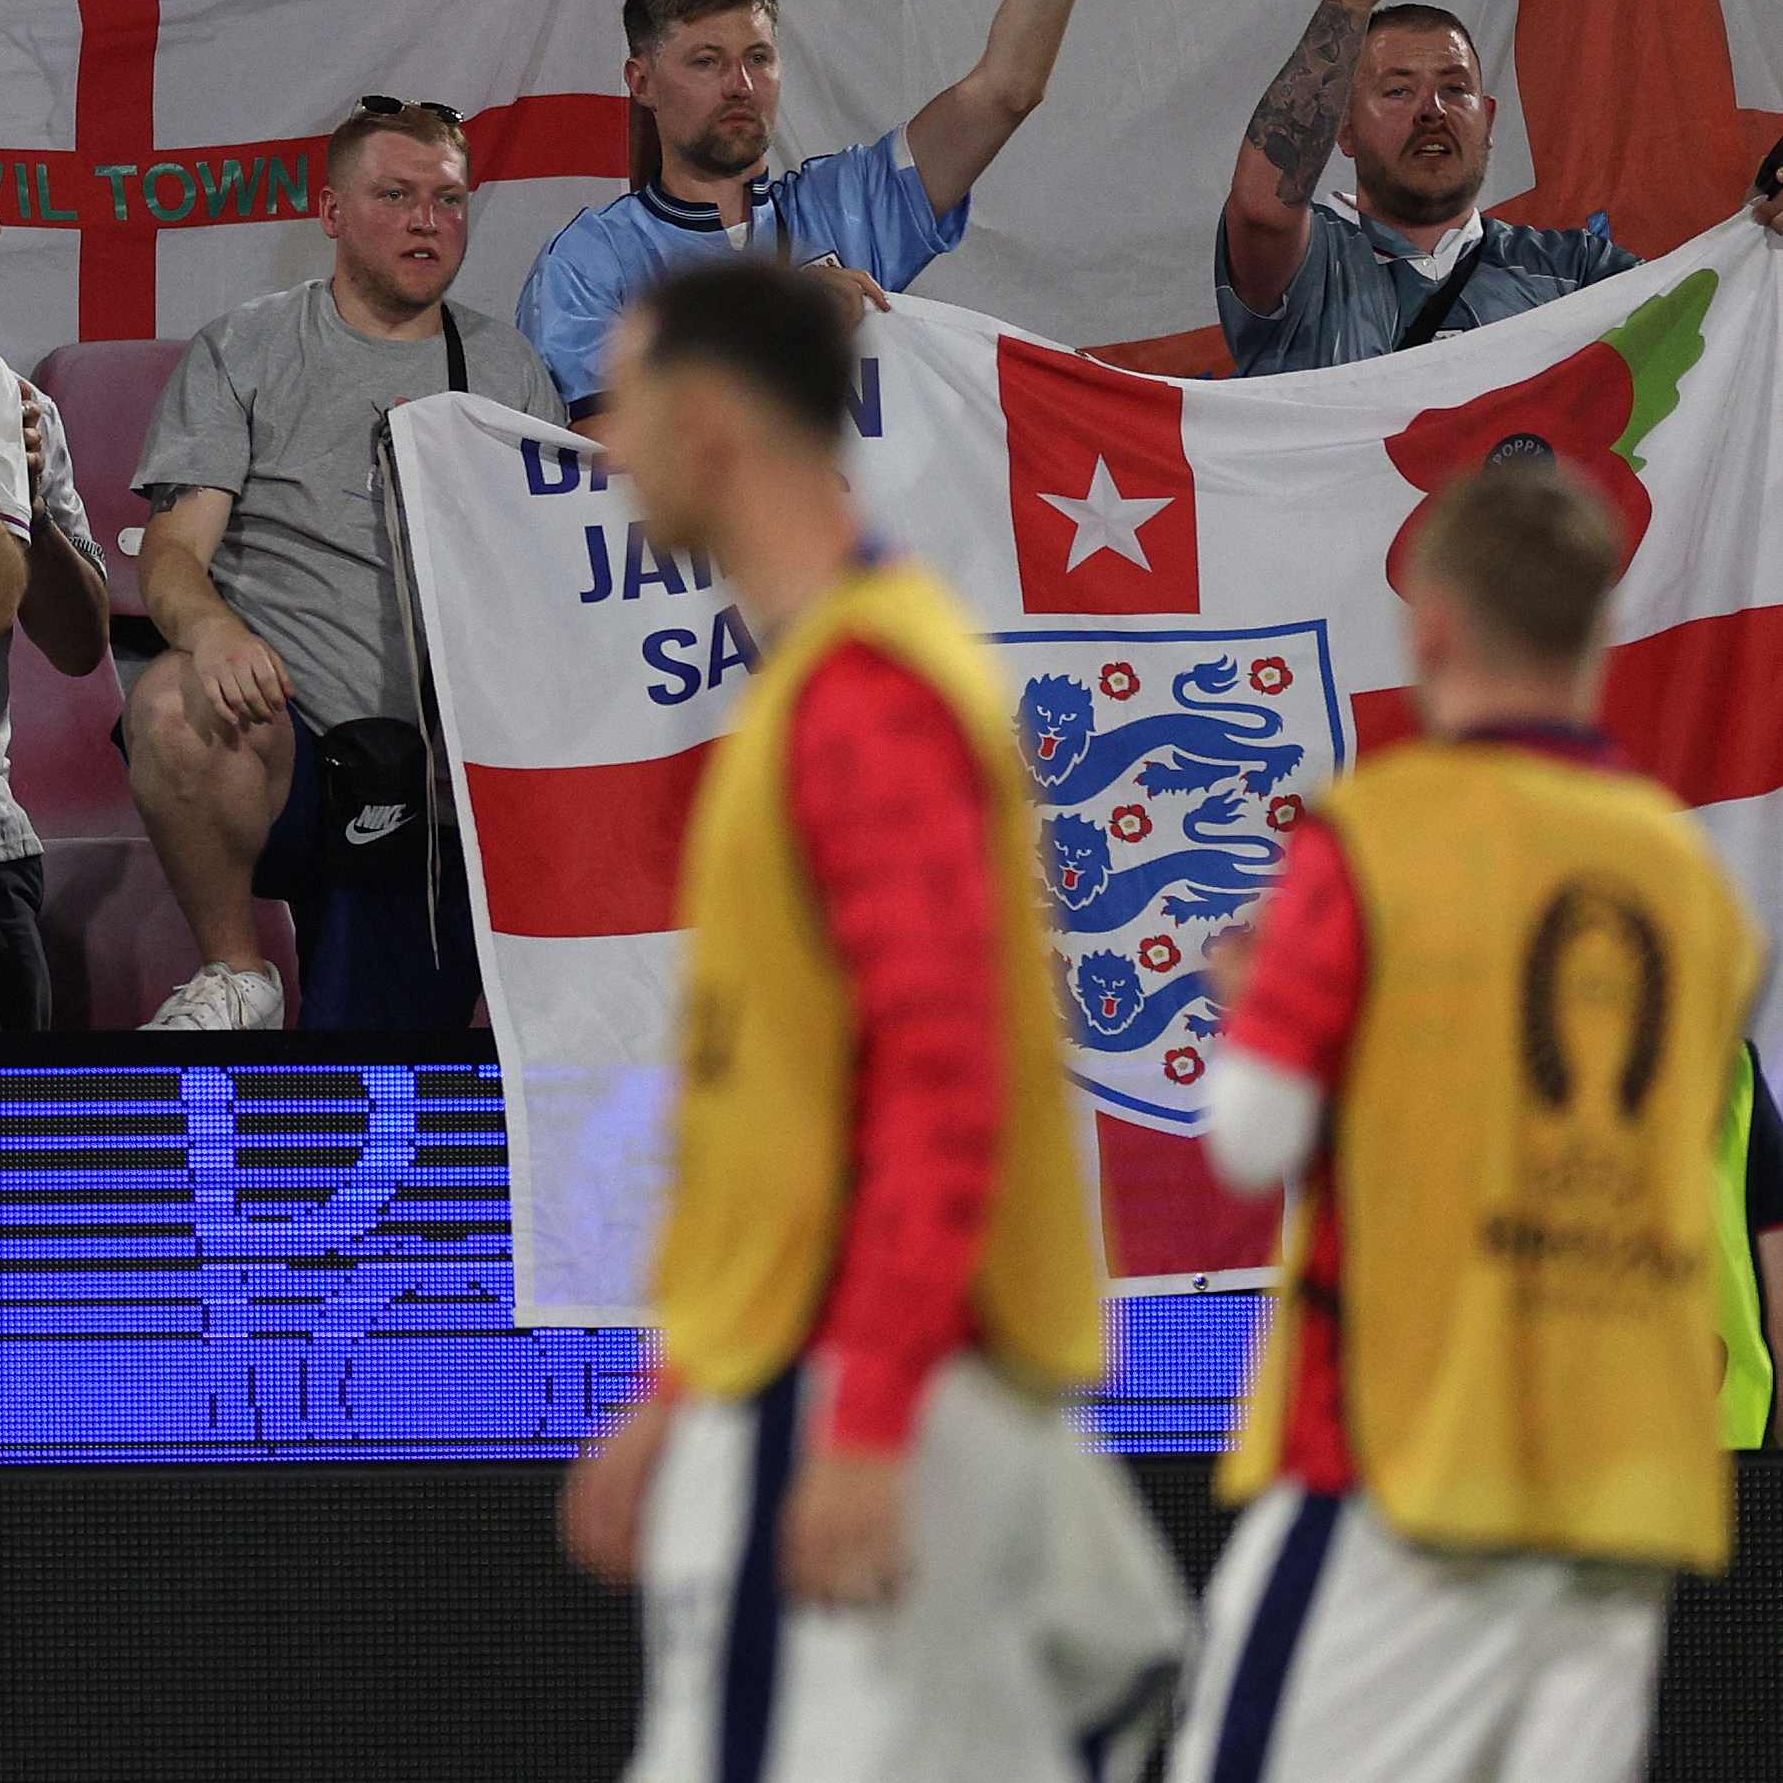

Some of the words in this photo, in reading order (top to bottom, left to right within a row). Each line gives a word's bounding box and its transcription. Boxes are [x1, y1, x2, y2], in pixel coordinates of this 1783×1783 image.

[94, 153, 310, 222] TOWN
[1491, 438, 1547, 467] POPPY
[580, 520, 726, 604] JA
[354, 802, 408, 831] NIKE
